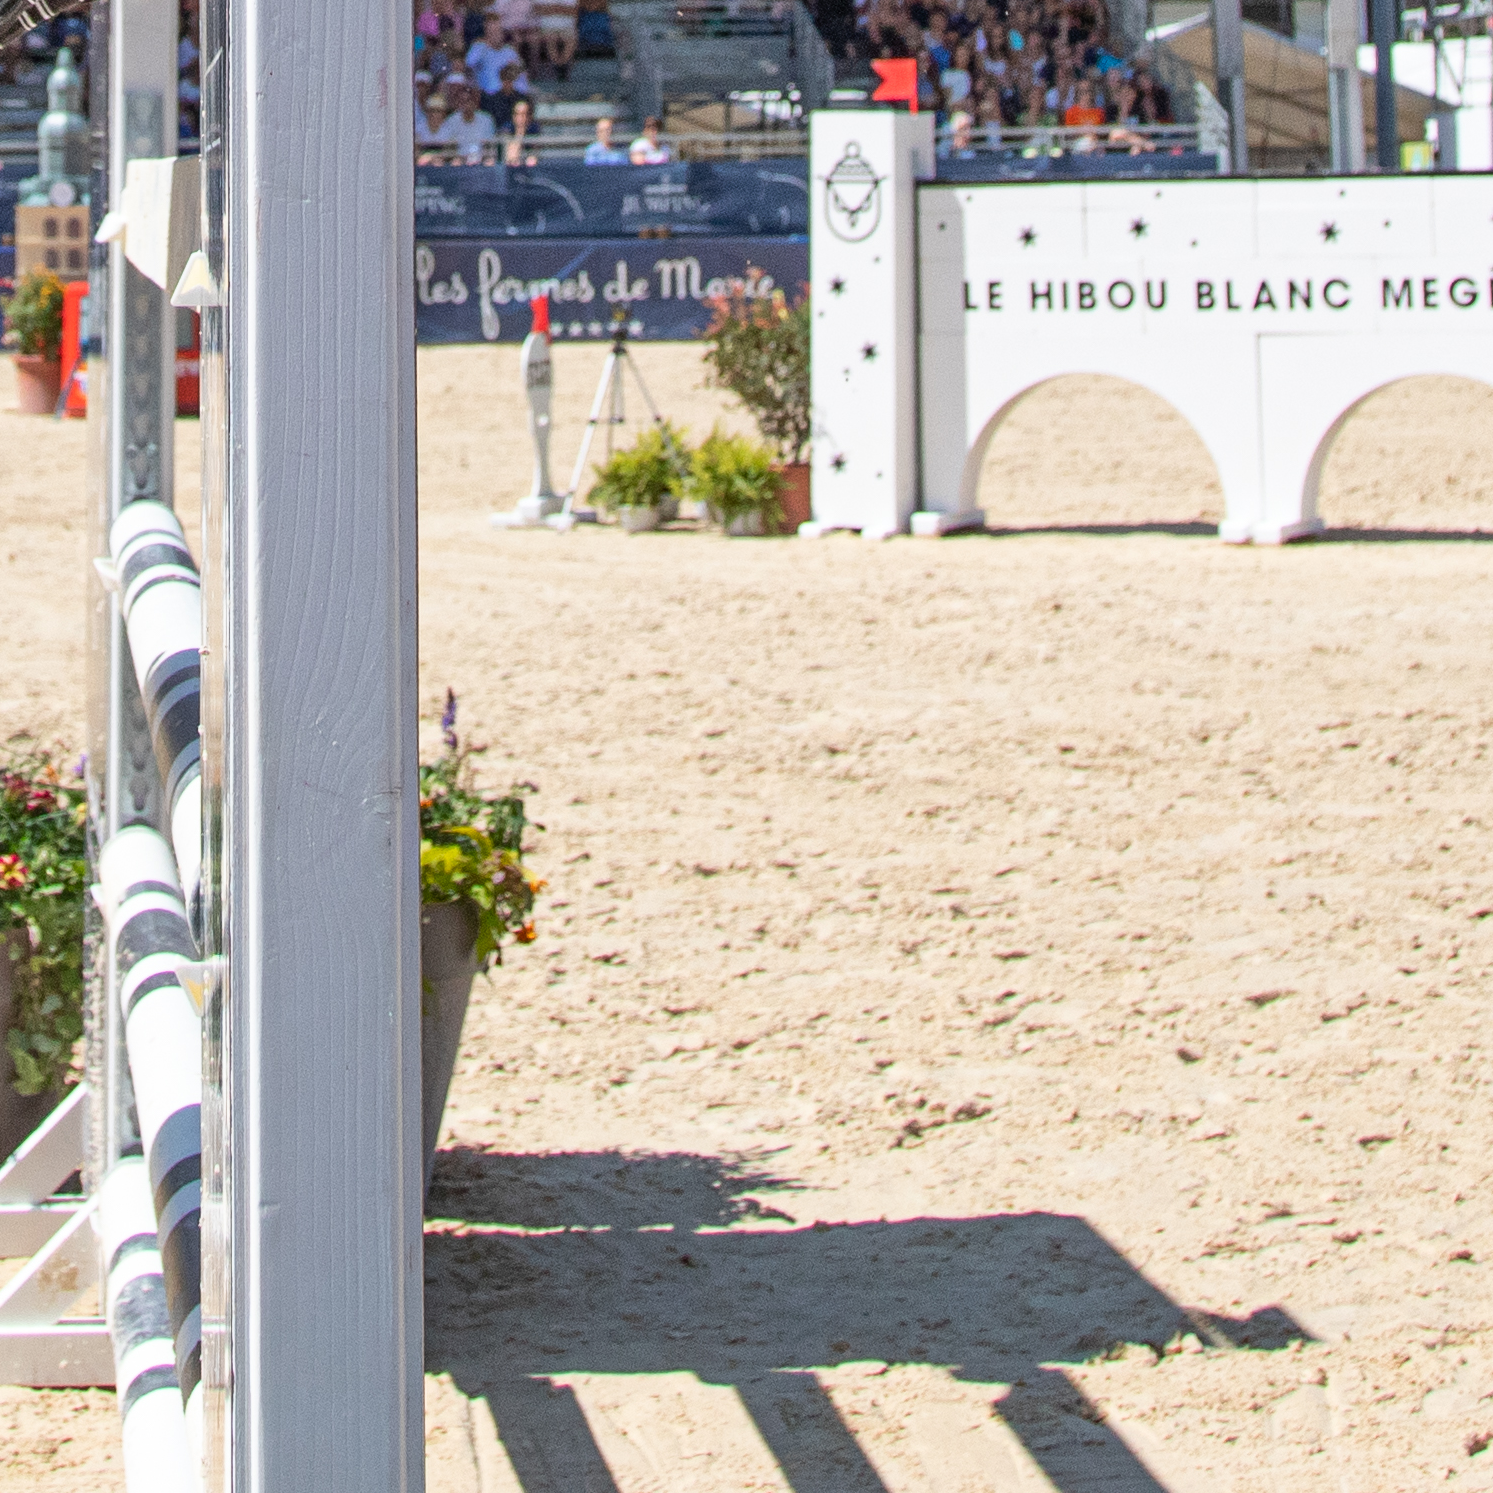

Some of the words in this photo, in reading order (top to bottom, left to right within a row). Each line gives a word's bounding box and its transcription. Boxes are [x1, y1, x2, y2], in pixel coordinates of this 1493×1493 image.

[603, 259, 650, 303] de
[962, 279, 1004, 311] LE
[1029, 278, 1168, 311] HIBOU
[1194, 278, 1352, 311] BLANC
[1381, 267, 1493, 311] MEG
